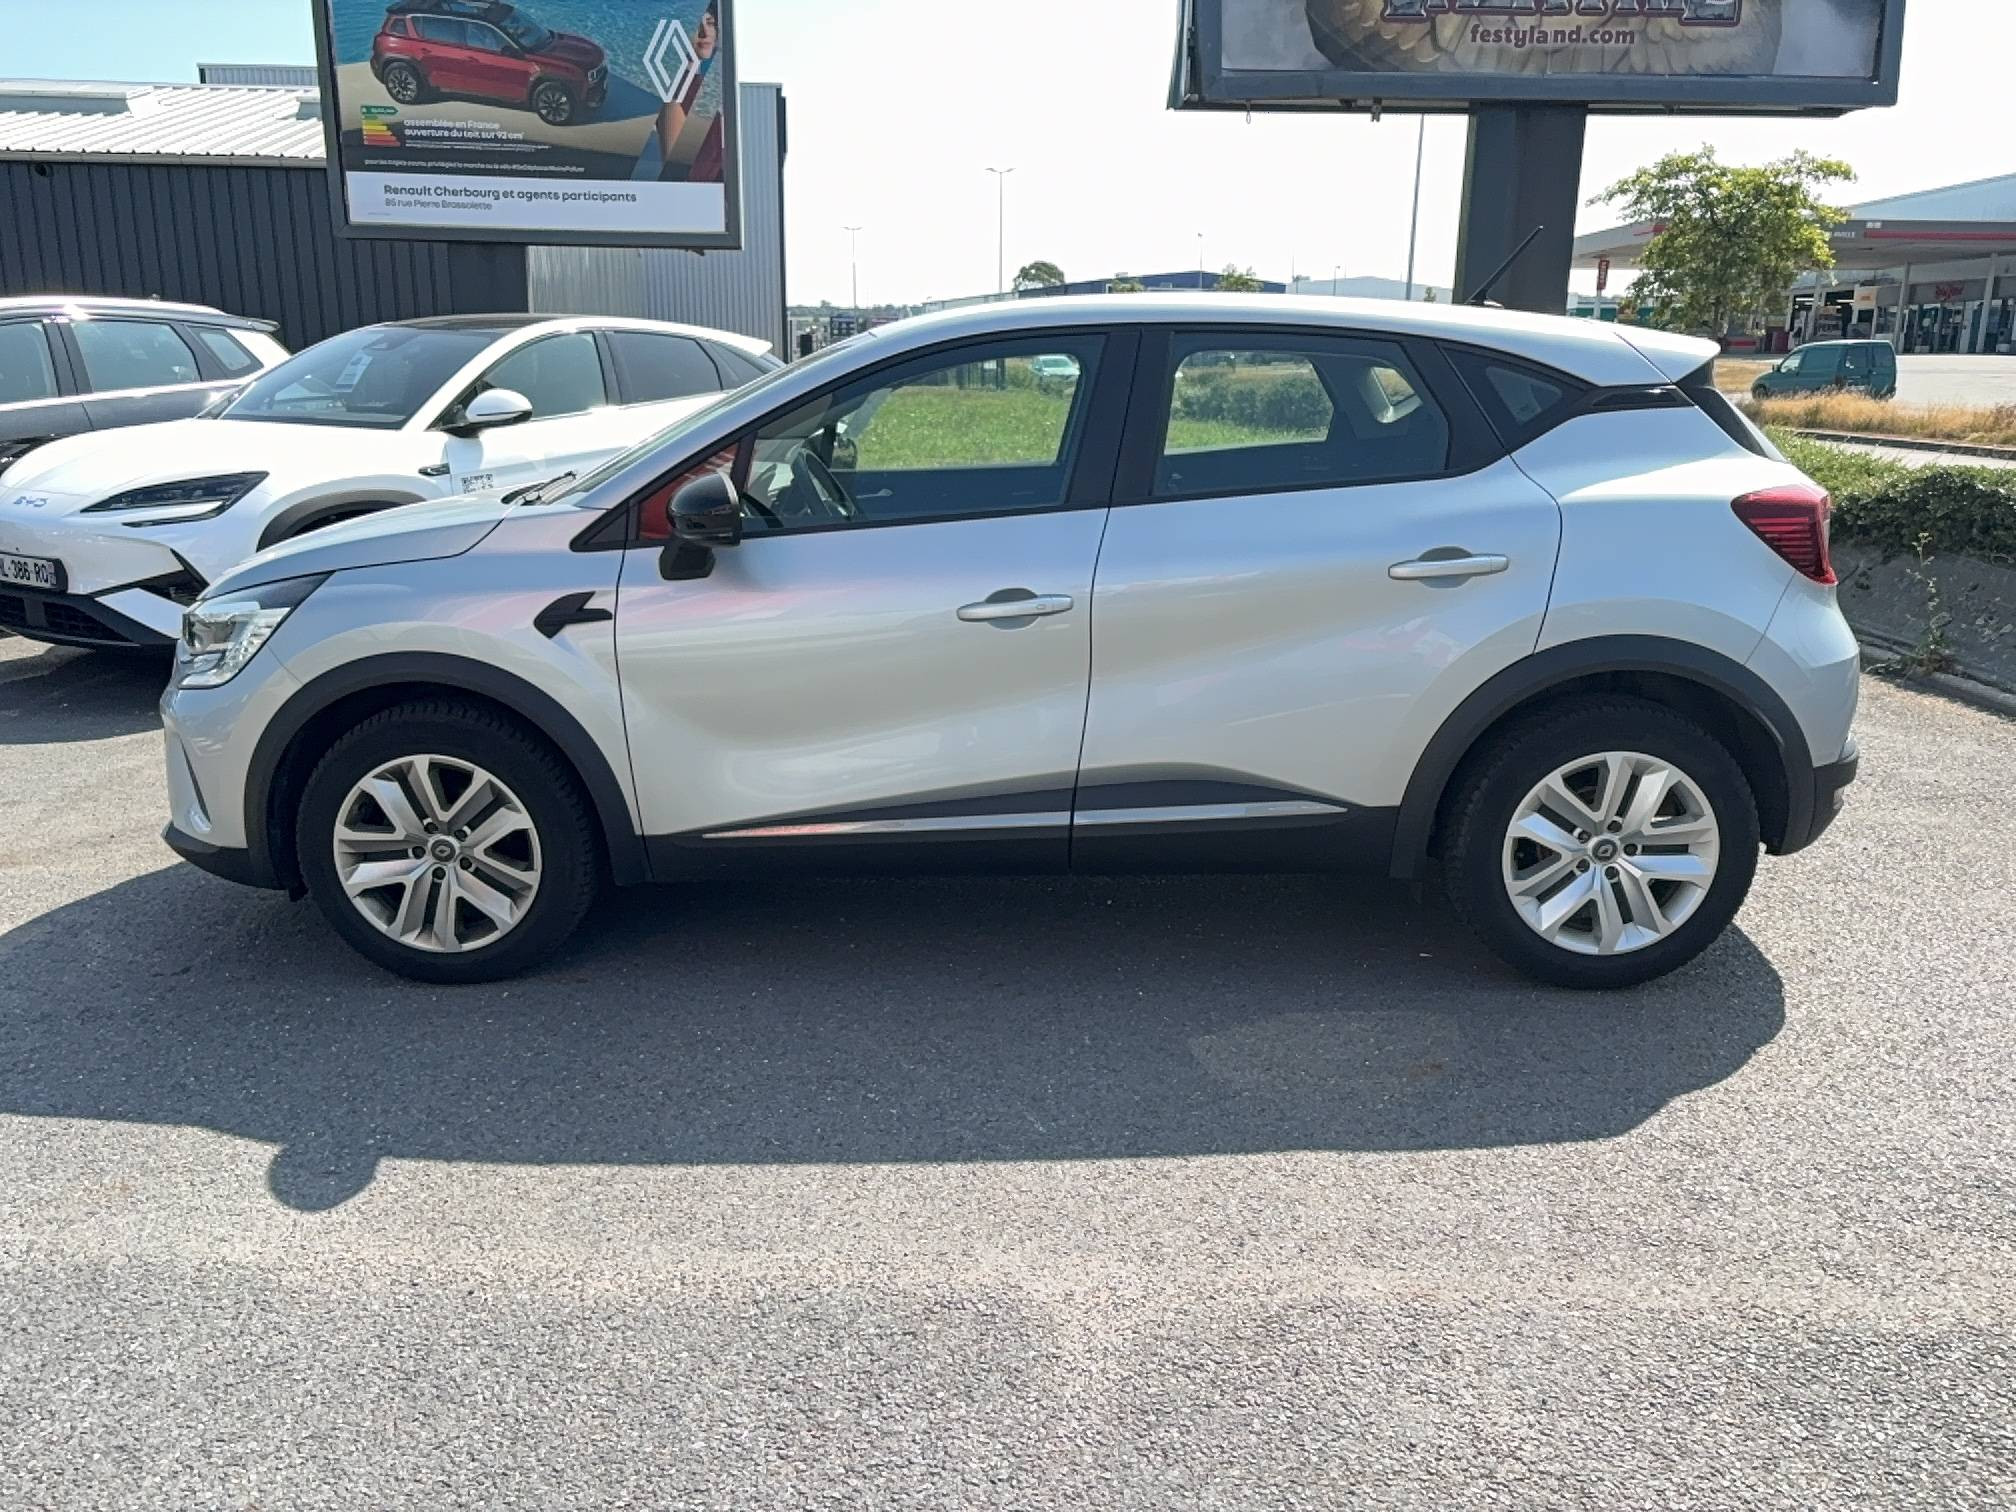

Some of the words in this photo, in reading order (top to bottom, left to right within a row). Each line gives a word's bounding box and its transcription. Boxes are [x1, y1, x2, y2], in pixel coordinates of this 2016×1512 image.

[1470, 24, 1635, 48] festyland.com
[384, 184, 432, 197] Renault
[434, 186, 500, 201] Cherbourg
[502, 190, 514, 199] et
[517, 191, 560, 202] agents
[562, 190, 637, 203] participants
